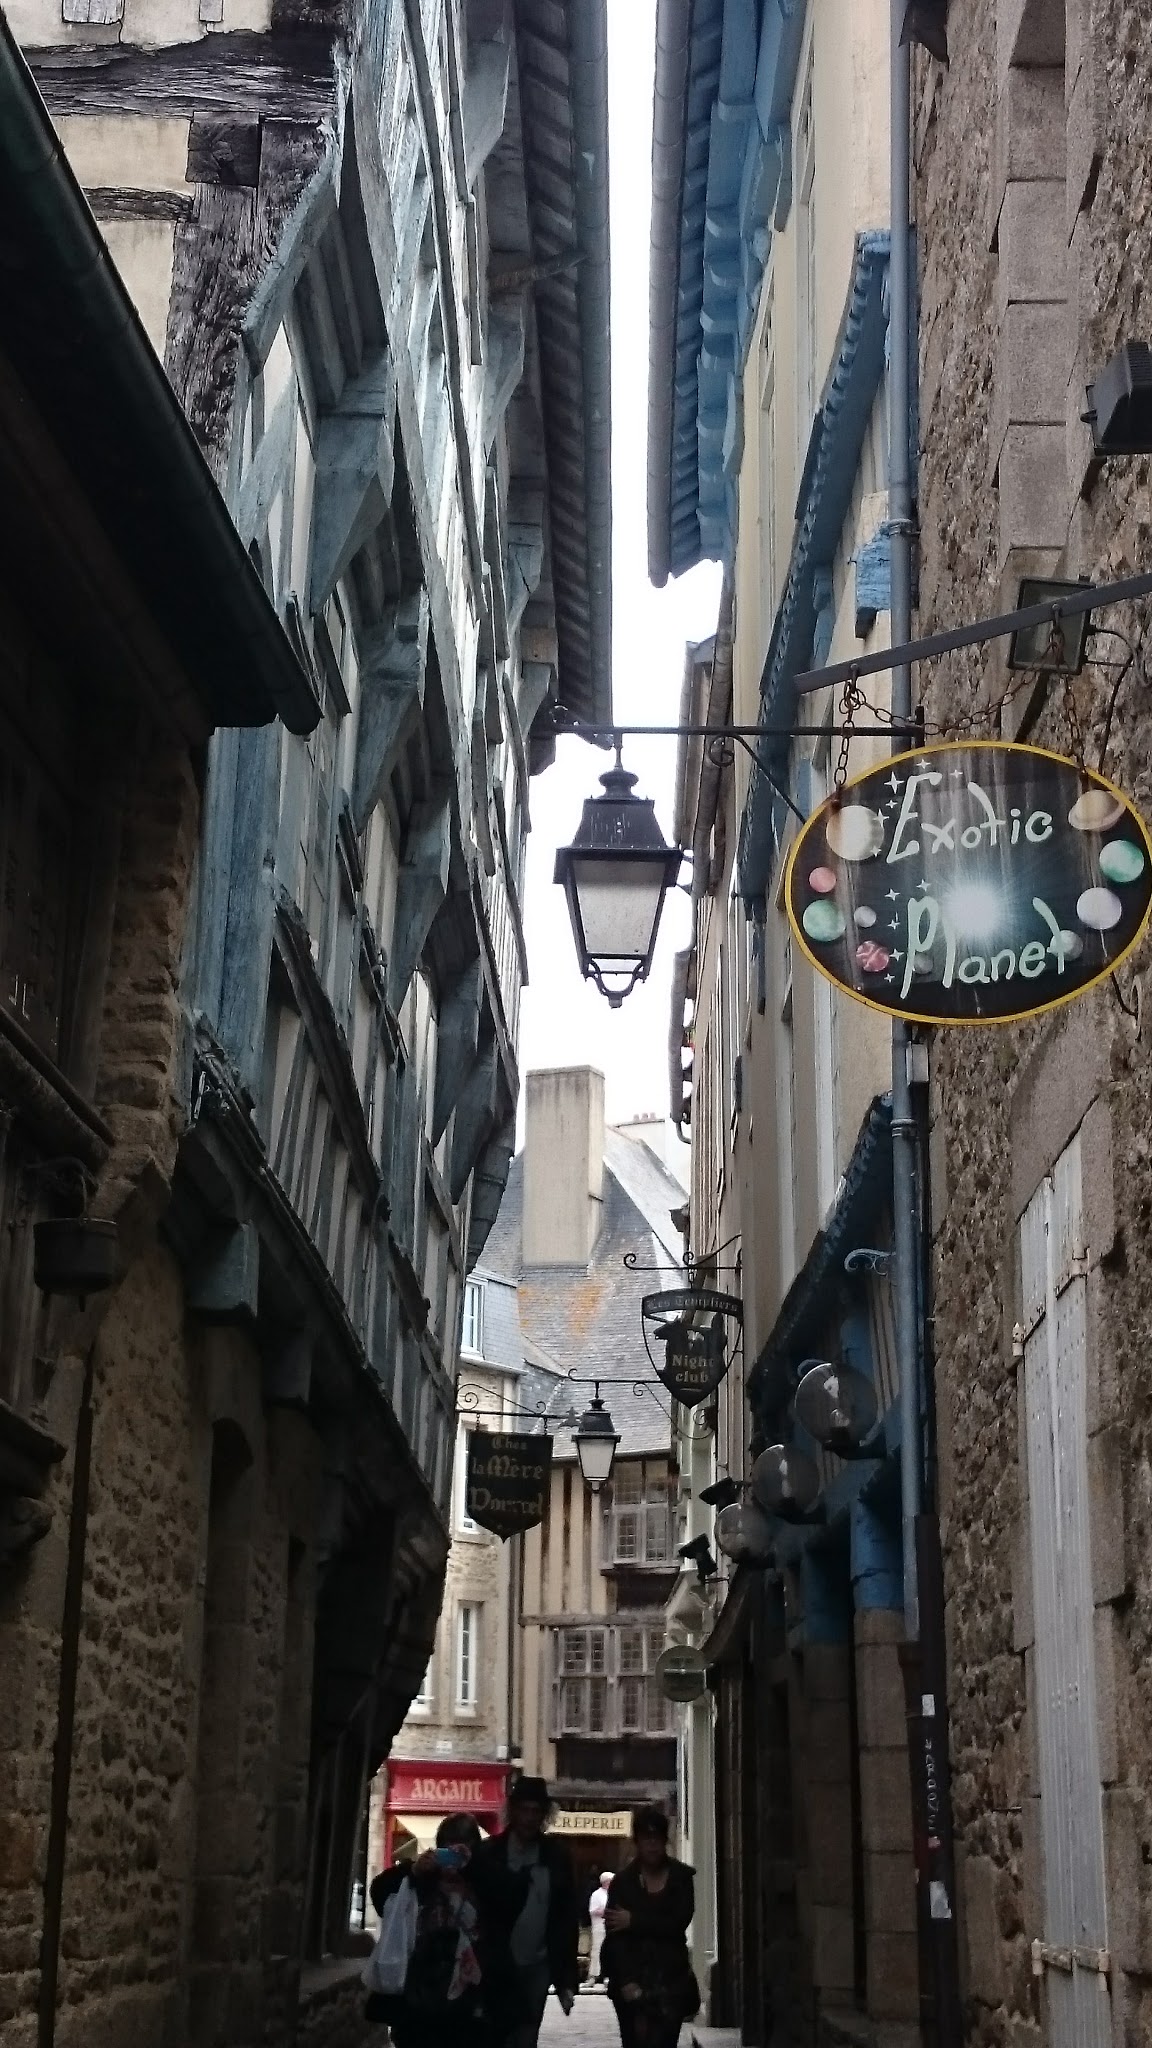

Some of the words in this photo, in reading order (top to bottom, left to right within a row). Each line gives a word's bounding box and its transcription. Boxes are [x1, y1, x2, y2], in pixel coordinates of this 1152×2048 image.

[887, 771, 1053, 864] Exotic
[899, 896, 1067, 999] Planet
[671, 1354, 715, 1370] Night
[675, 1371, 709, 1383] club
